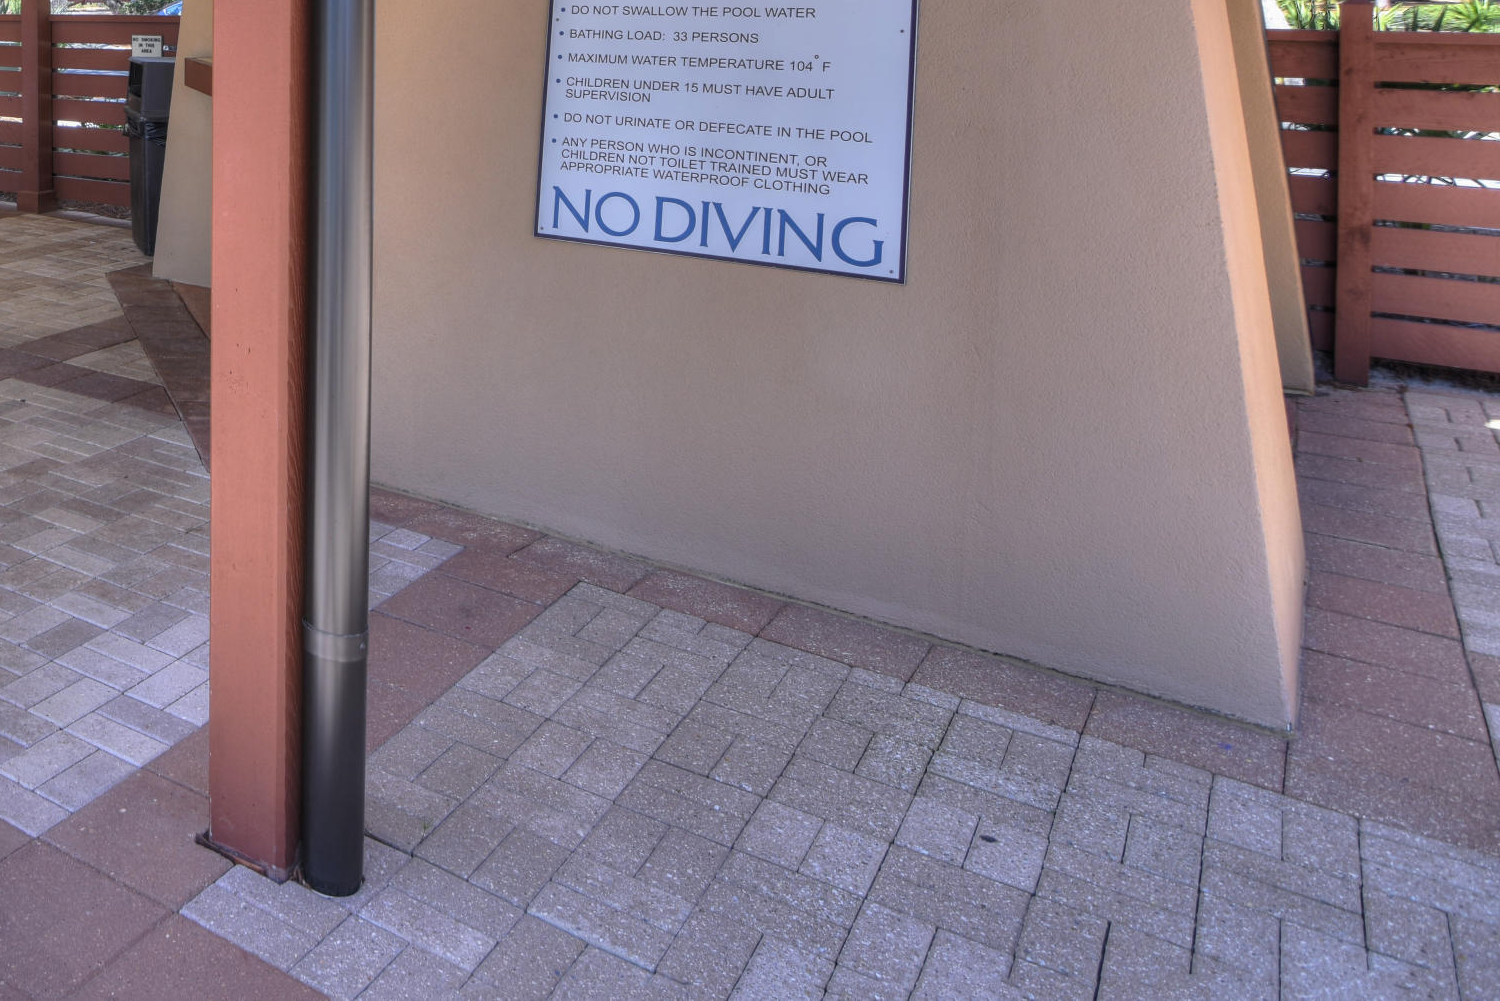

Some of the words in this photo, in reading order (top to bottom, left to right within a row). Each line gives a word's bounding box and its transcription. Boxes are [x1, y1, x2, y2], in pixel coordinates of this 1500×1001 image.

[571, 5, 590, 15] DO
[592, 5, 619, 15] NOT
[622, 6, 688, 16] SWALLOW
[691, 6, 719, 17] THE
[722, 7, 761, 18] POOL
[764, 7, 816, 18] WATER
[569, 29, 623, 40] BATHING
[627, 30, 666, 41] LOAD:
[673, 31, 688, 42] 33
[692, 32, 759, 44] PERSONS
[568, 53, 628, 65] MAXIMUM
[631, 55, 677, 66] WATER
[681, 56, 784, 71] TEMPERATURE
[822, 61, 832, 73] F
[565, 89, 651, 103] SUPERVISION
[566, 76, 630, 89] CHILDREN
[633, 80, 680, 92] UNDER
[684, 83, 699, 93] 15
[702, 83, 742, 95] MUST
[745, 85, 783, 97] HAVE
[786, 87, 835, 100] ADULT
[564, 112, 582, 123] DO
[585, 114, 612, 125] NOT
[615, 116, 671, 130] URINATE
[675, 119, 695, 131] OR
[699, 121, 773, 137] DEFECATE
[777, 126, 791, 138] IN
[795, 127, 825, 140] THE
[830, 130, 873, 144] POOL
[562, 136, 588, 148] ANY
[590, 138, 644, 153] PERSON
[647, 143, 680, 155] WHO
[684, 146, 697, 157] IS
[701, 147, 800, 167] INCONTINENT,
[804, 155, 828, 168] OR
[560, 161, 649, 179] APPROPRIATE
[653, 169, 750, 187] WATERPROOF
[753, 178, 830, 195] CLOTHING
[561, 148, 625, 163] CHILDREN
[628, 154, 657, 166] NOT
[659, 156, 707, 171] TOILET
[710, 161, 772, 176] TRAINED
[776, 166, 818, 180] MUST
[821, 170, 869, 185] WEAR
[553, 185, 641, 237] NO
[653, 196, 885, 268] DIVING
